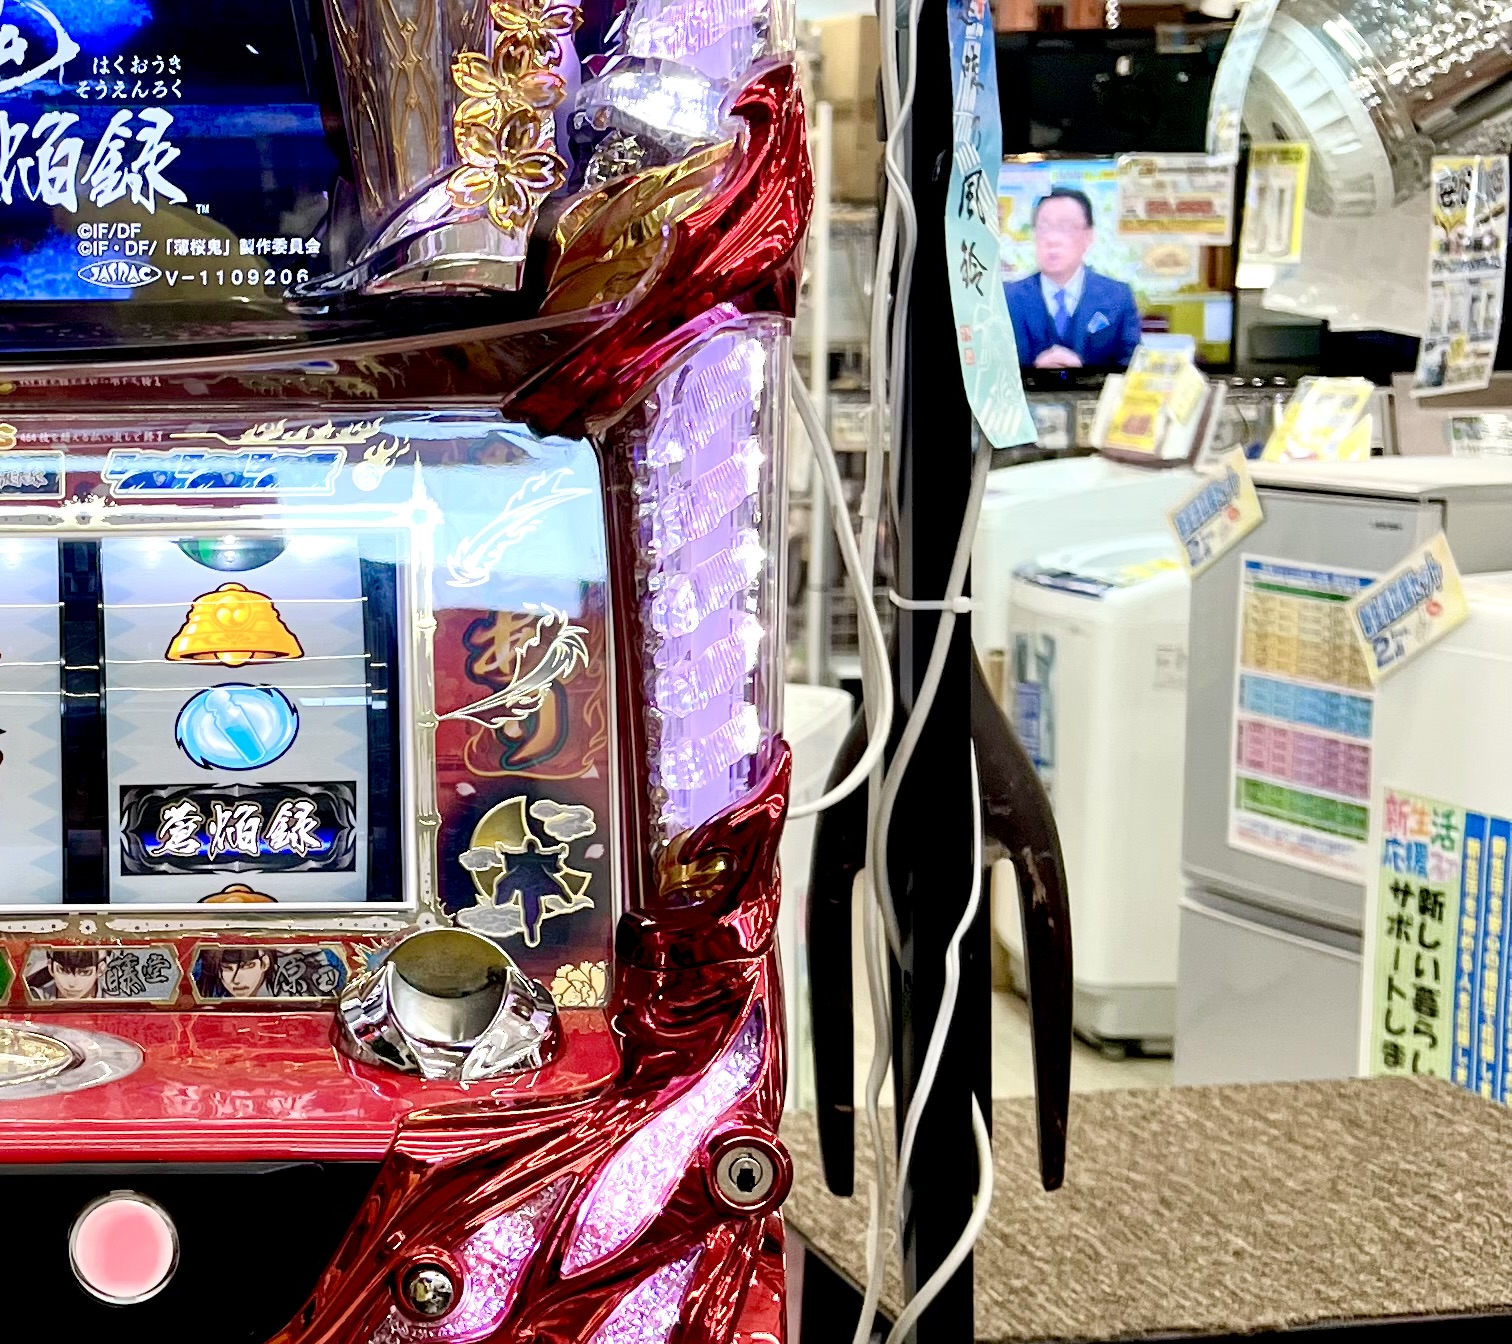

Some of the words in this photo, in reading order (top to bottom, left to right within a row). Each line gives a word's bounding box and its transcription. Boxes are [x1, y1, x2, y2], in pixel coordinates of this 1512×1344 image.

[92, 55, 183, 76] はくおうき
[75, 78, 183, 100] そうえんろく
[148, 799, 320, 860] 蒼焔録
